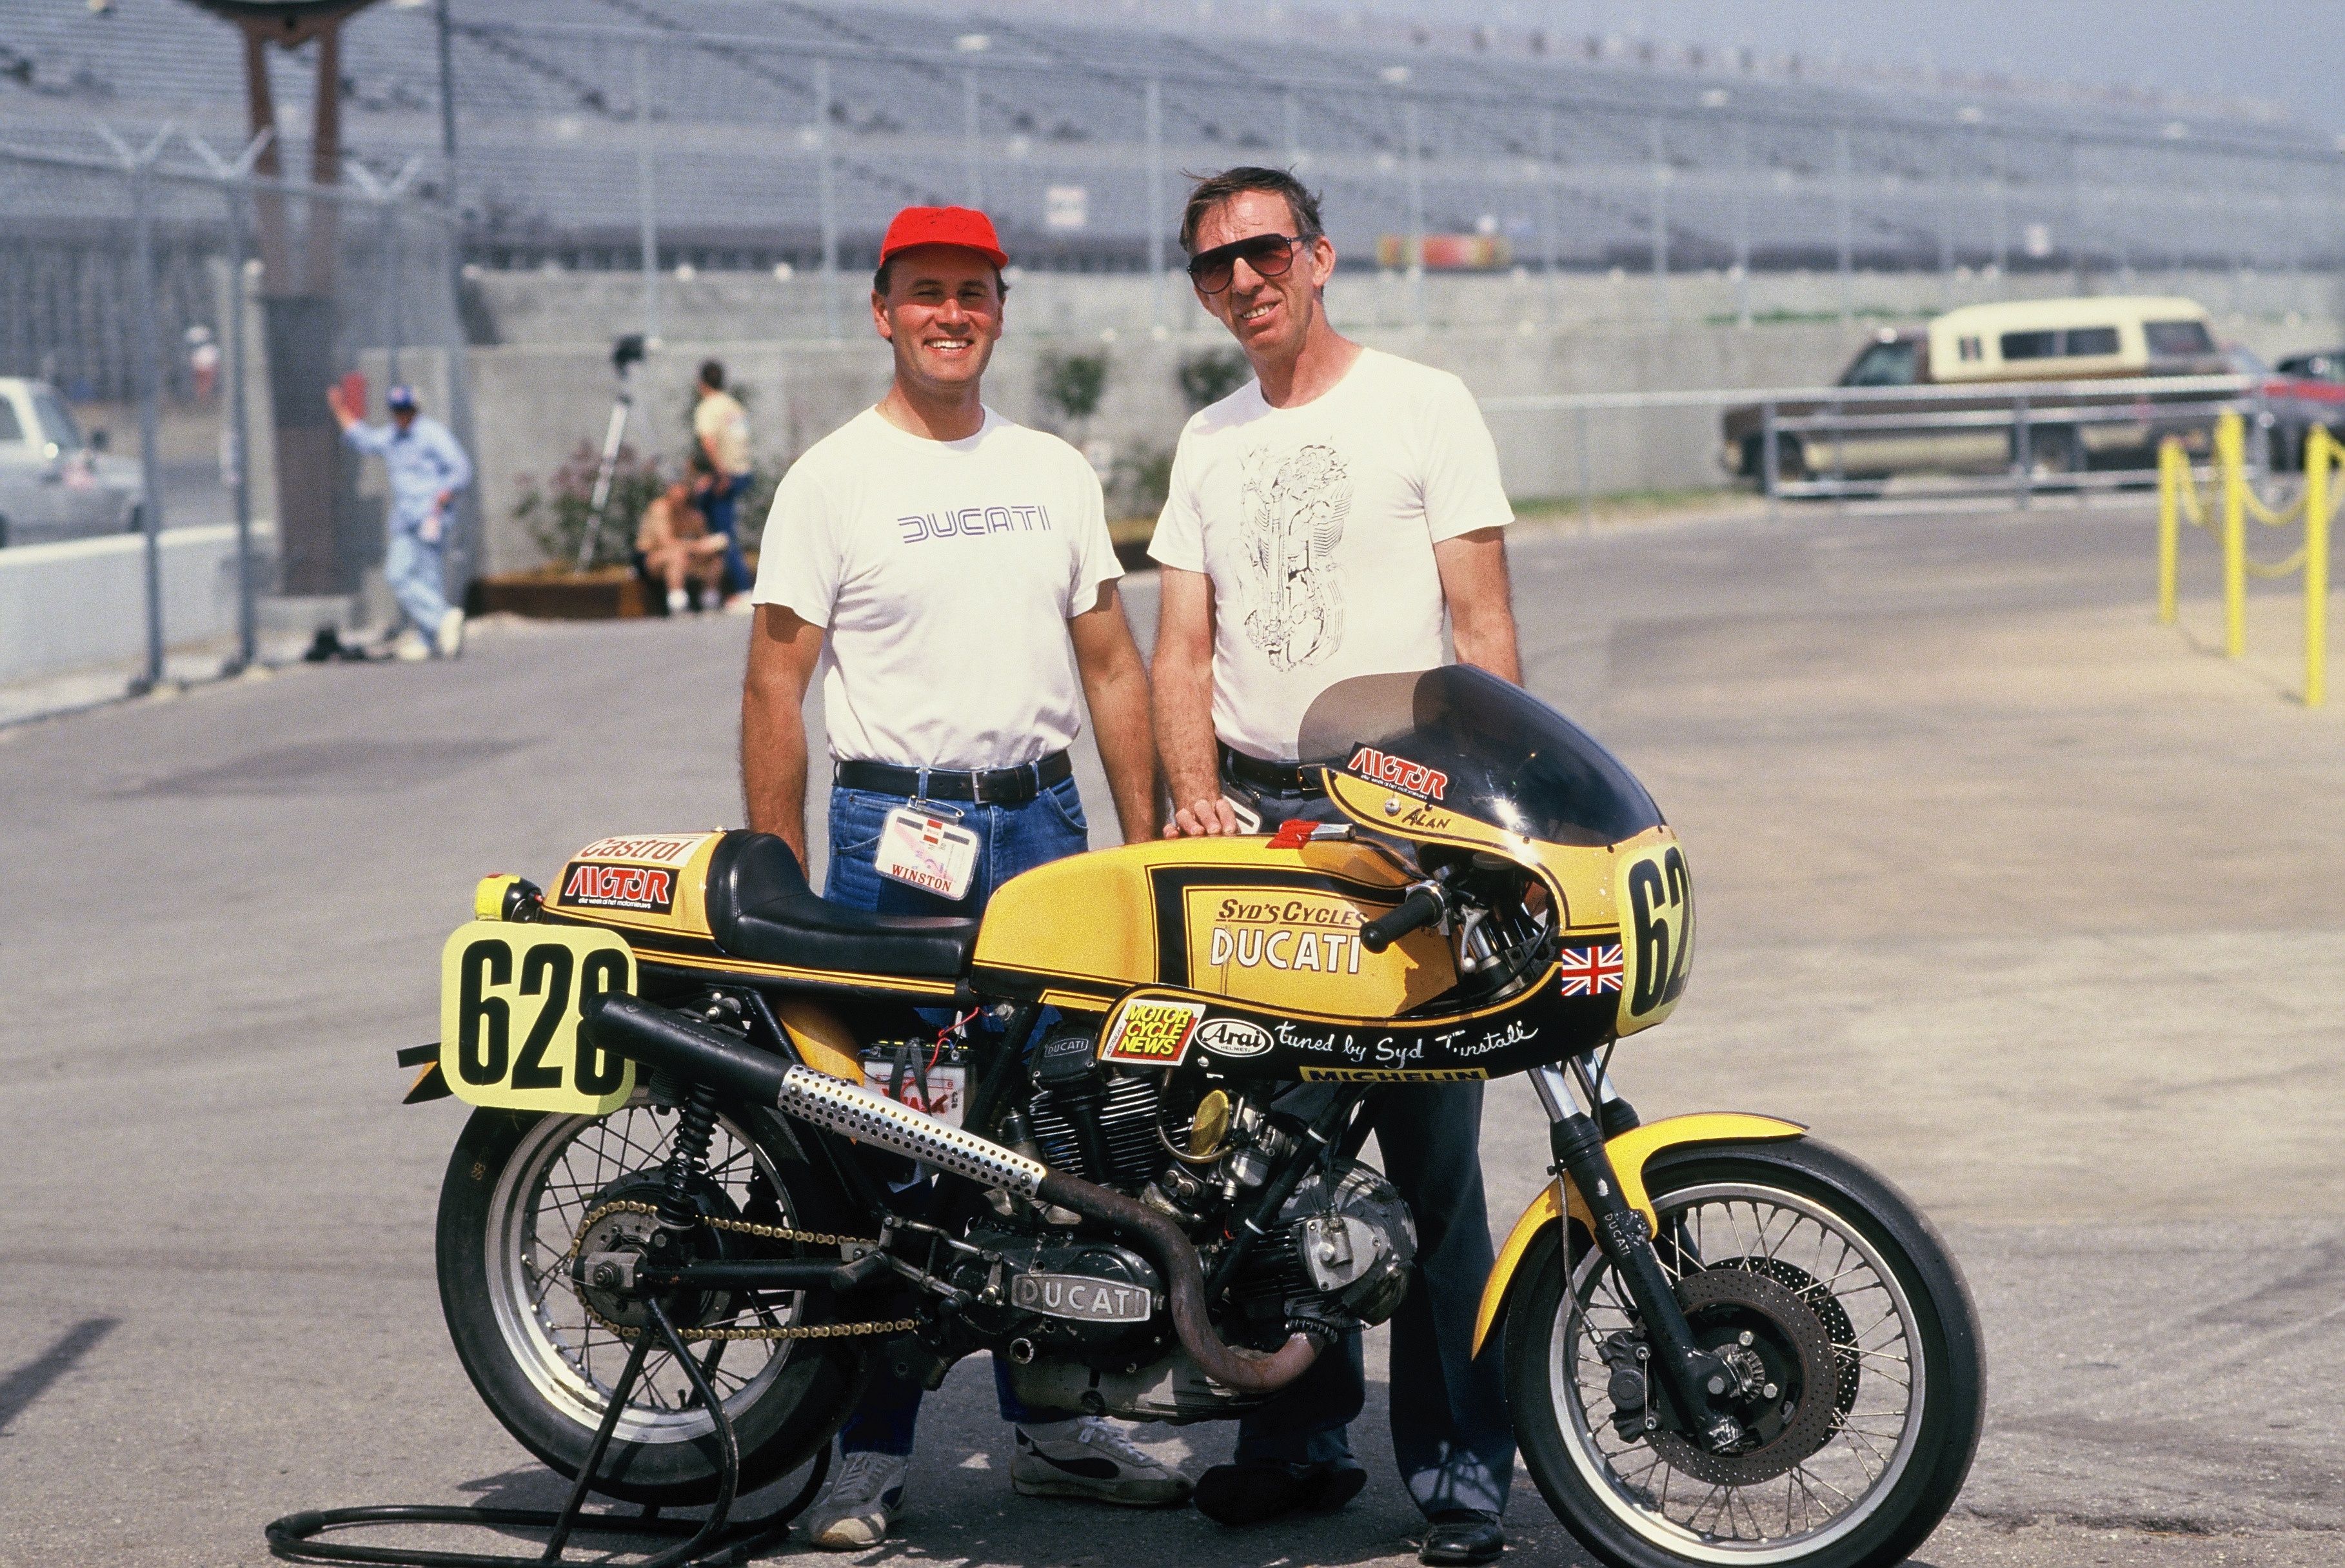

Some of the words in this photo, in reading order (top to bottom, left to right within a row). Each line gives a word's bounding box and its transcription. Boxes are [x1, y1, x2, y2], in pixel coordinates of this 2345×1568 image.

[897, 505, 1051, 544] DUCATI
[1347, 747, 1448, 801] MOTOR
[580, 838, 695, 861] Castrol
[565, 866, 669, 904] MOTOR
[893, 864, 952, 892] WINSTON
[1211, 926, 1361, 974] DUCATI
[459, 939, 629, 1096] 628
[1125, 1004, 1192, 1024] MOTOR
[1126, 1020, 1186, 1039] CYCLE
[1048, 1041, 1084, 1055] DUCATI
[1118, 1036, 1176, 1055] NEWS
[1201, 1024, 1262, 1048] Arai
[1274, 1021, 1335, 1052] tuned
[1341, 1035, 1367, 1062] by
[1376, 1037, 1424, 1070] Syd
[1308, 1070, 1481, 1082] MICHELIN
[1604, 1213, 1630, 1255] DUCATI
[1022, 1279, 1140, 1316] DUCATI
